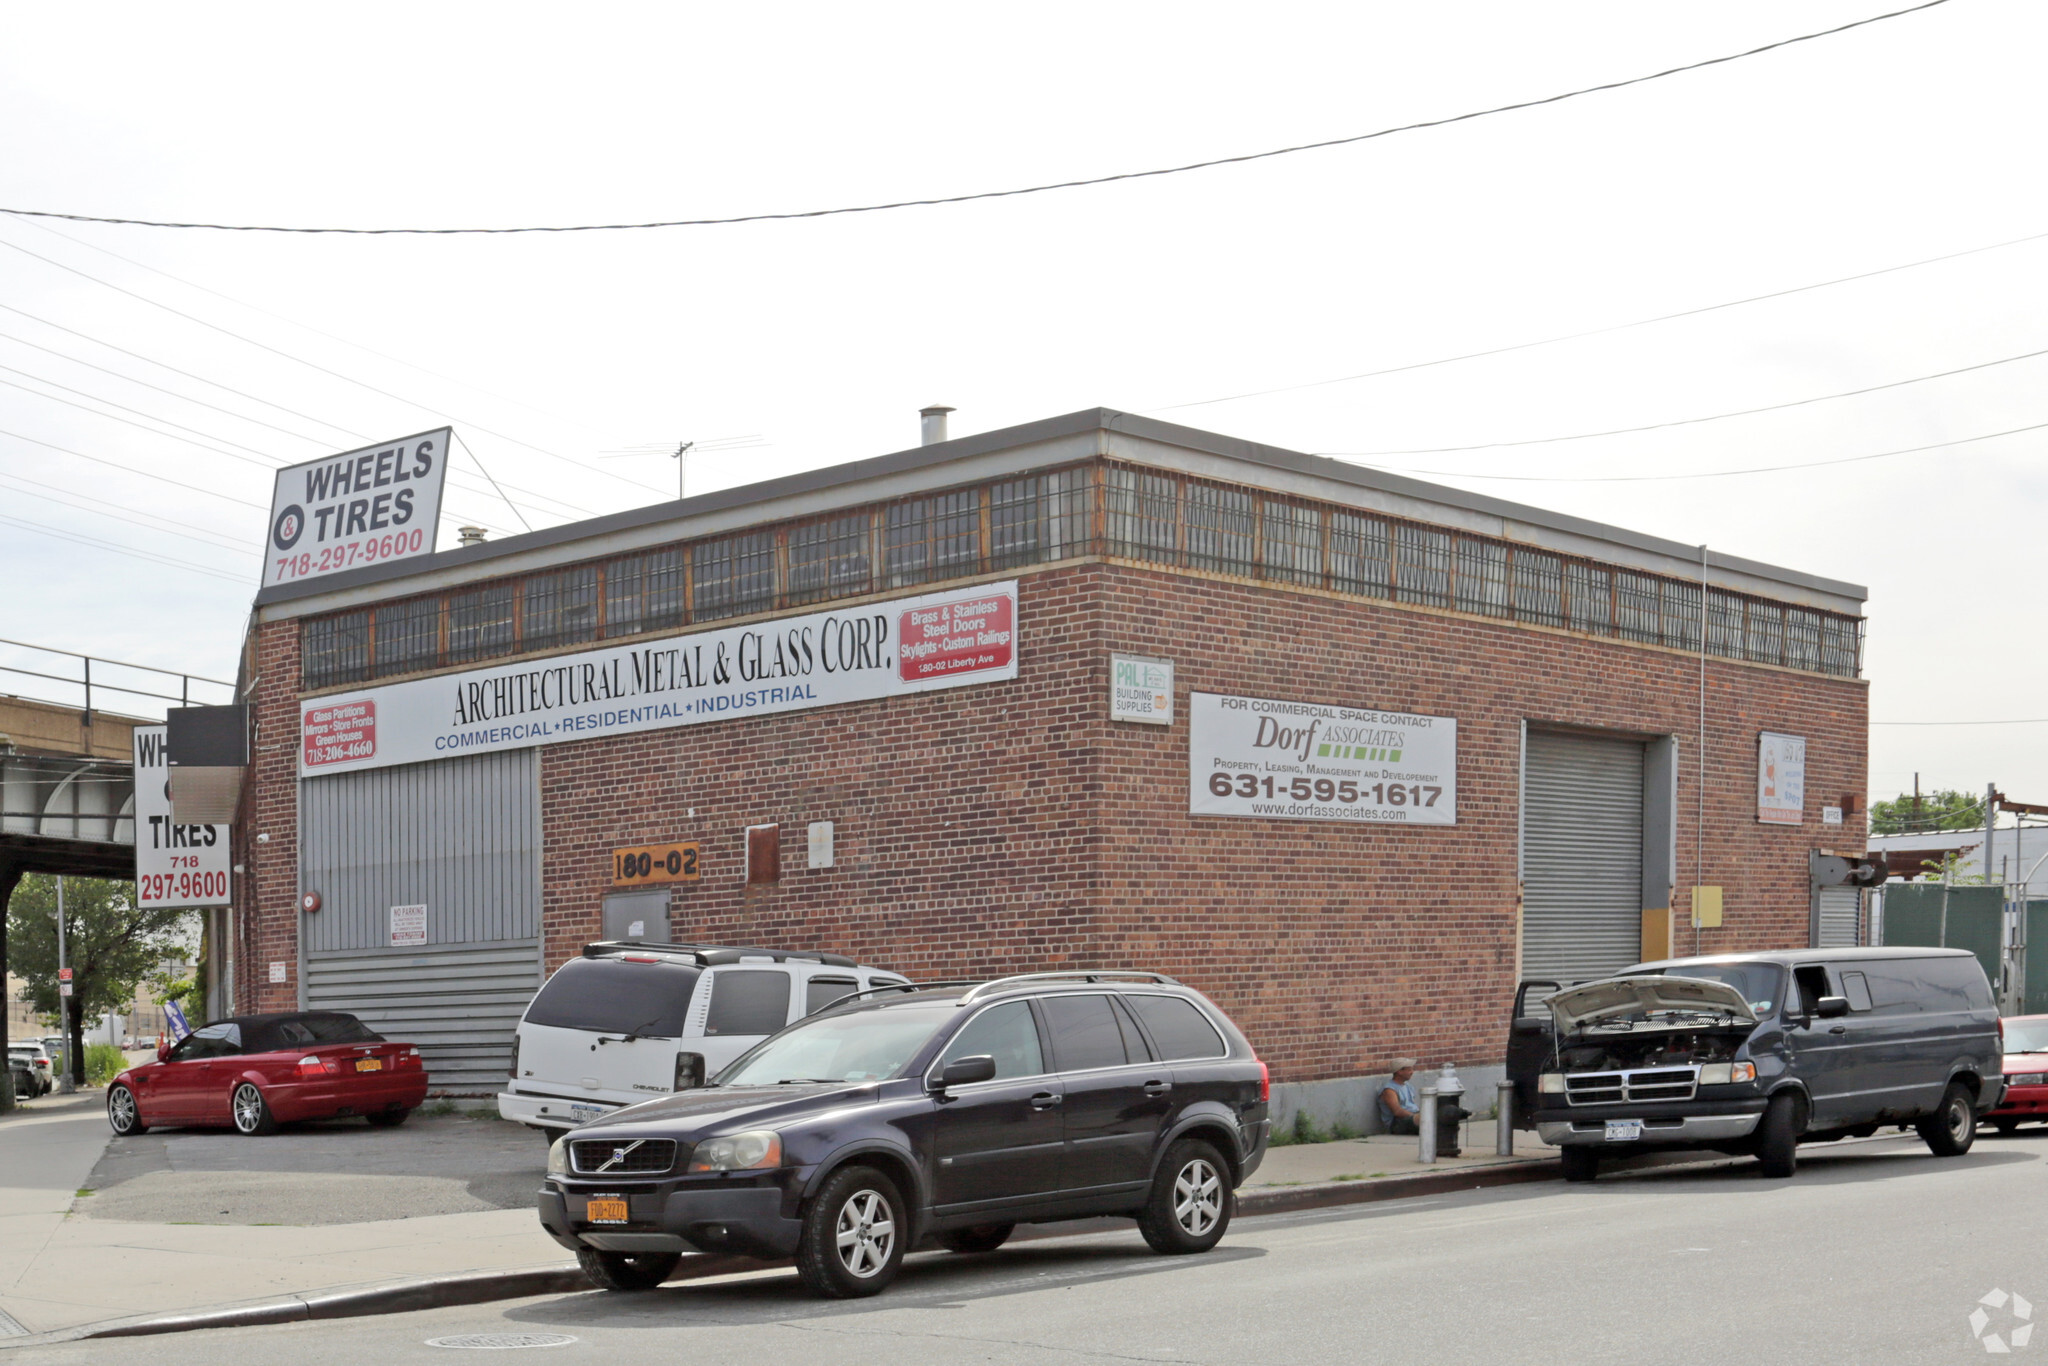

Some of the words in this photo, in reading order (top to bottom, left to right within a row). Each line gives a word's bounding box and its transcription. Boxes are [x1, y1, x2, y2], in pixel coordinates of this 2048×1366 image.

[306, 440, 434, 504] WHEELS
[283, 516, 295, 537] &
[314, 488, 415, 543] TIRES
[276, 528, 423, 581] 718-297-9600
[911, 611, 939, 626] Brass
[941, 606, 951, 621] &
[953, 601, 999, 619] Stainless
[922, 621, 950, 638] Steel
[953, 618, 986, 633] Doors
[901, 640, 937, 660] Skylights
[942, 635, 975, 651] Custom
[977, 629, 1011, 646] Railings
[452, 656, 626, 727] ARCHITECTURAL
[630, 645, 708, 696] METAL
[712, 640, 731, 686] &
[738, 625, 814, 683] GLASS
[820, 614, 892, 675] CORP.
[947, 656, 977, 670] Liberty
[977, 654, 995, 665] Ave
[1116, 661, 1140, 687] PAL
[1116, 687, 1152, 701] BUILDING
[1116, 700, 1153, 713] SUPPLIES
[313, 711, 333, 723] Glass
[333, 706, 366, 719] Partitions
[333, 720, 352, 731] Store
[351, 716, 374, 728] Fronts
[434, 721, 553, 751] COMMERCIAL
[562, 702, 683, 733] RESIDENTIAL
[696, 682, 817, 714] INDUSTRIAL
[1220, 697, 1248, 711] FOR
[1251, 700, 1336, 719] COMMERCIAL
[1339, 709, 1379, 724] SPACE
[1381, 714, 1433, 728] CONTACT
[315, 735, 336, 746] Green
[336, 731, 363, 743] Houses
[1252, 715, 1322, 763] Dorf
[1322, 725, 1405, 748] ASSOCIATES
[307, 740, 373, 764] 718-206-4660
[1213, 757, 1262, 773] PROPERTY,
[1265, 760, 1303, 775] LEASING,
[1306, 763, 1361, 778] MANAGEMENT
[1364, 770, 1380, 779] AND
[1381, 768, 1439, 783] DEVELOPEMENT
[1208, 771, 1442, 807] 631-595-1617
[1251, 802, 1407, 820] www.dorfassociates.com
[148, 815, 217, 849] TIRES
[169, 855, 199, 868] 718
[615, 848, 698, 880] 180-02
[141, 870, 226, 901] 297-9600
